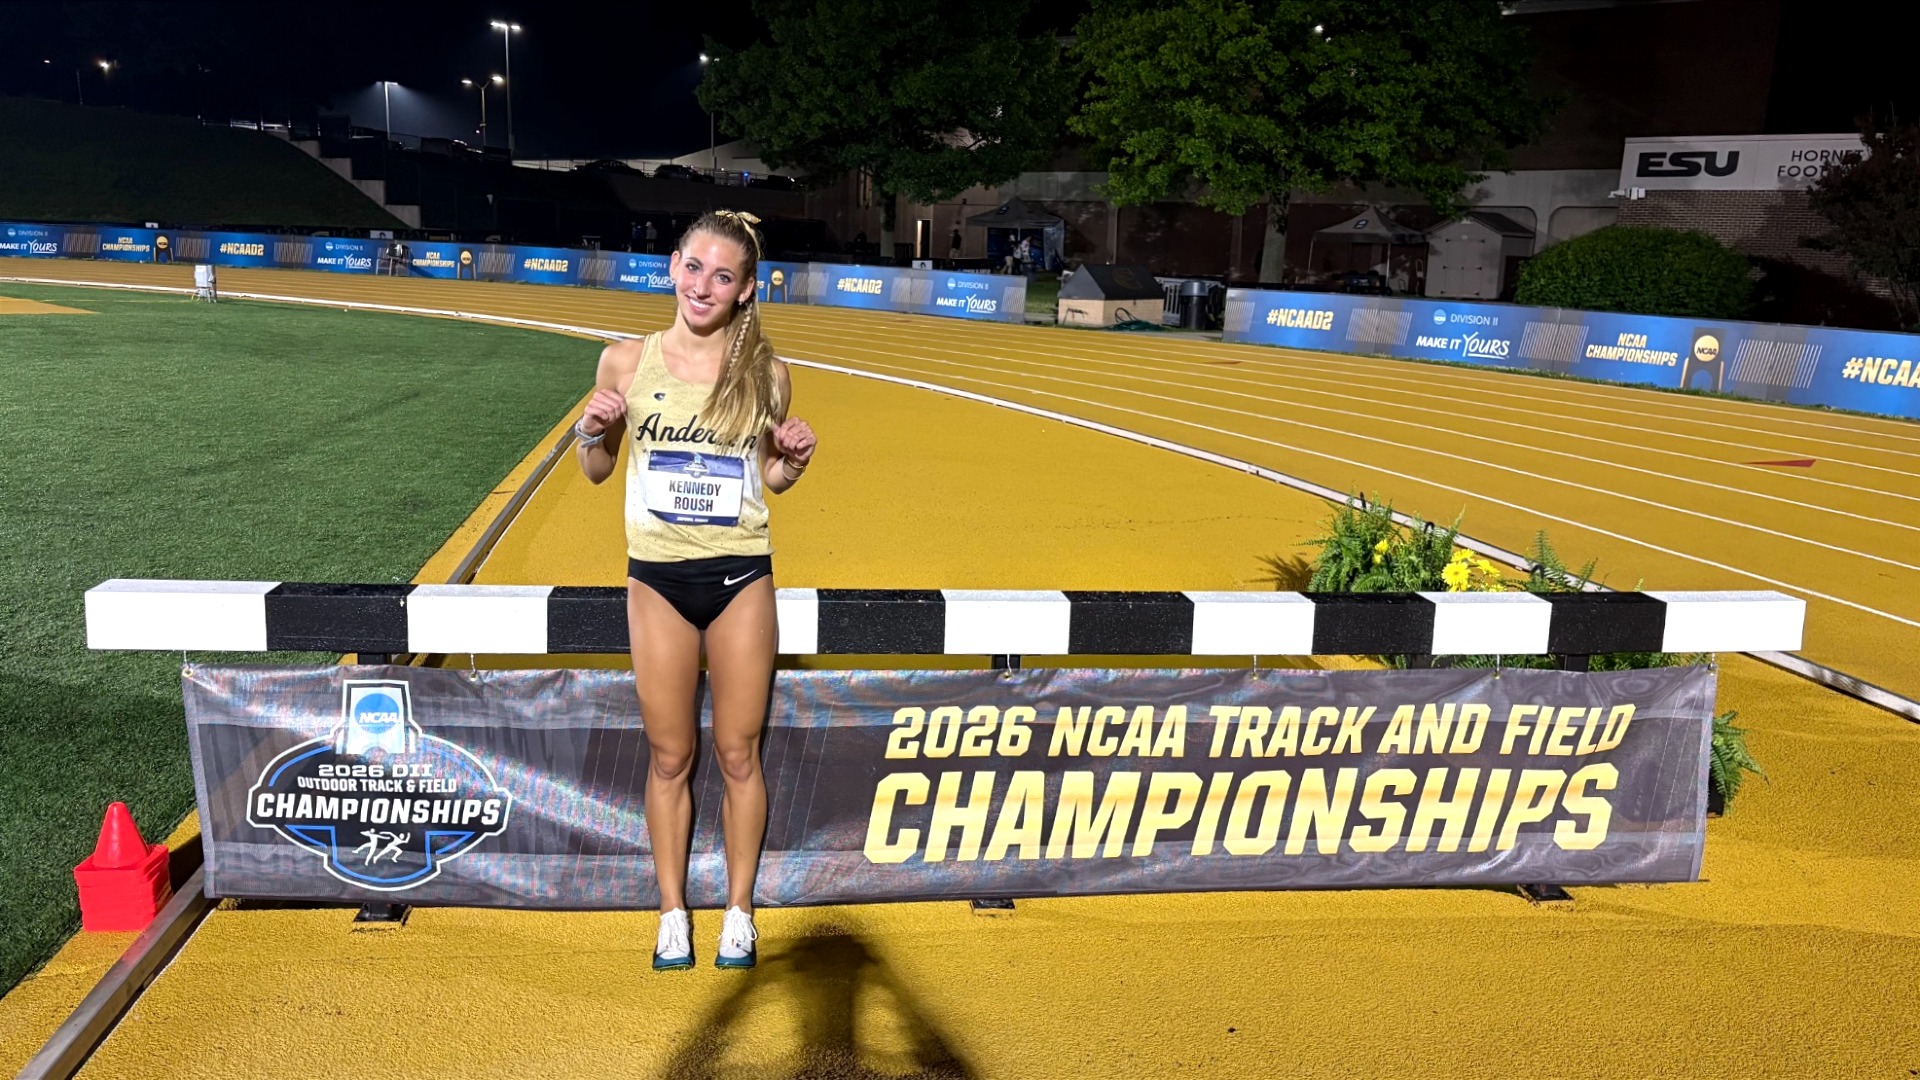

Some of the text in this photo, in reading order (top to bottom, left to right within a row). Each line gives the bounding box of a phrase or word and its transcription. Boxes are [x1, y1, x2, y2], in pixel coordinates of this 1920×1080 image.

[1636, 151, 1740, 178] ESU
[28, 239, 58, 254] YOURS
[102, 243, 150, 252] CHAMPIONSHIPS
[220, 242, 264, 256] #NCAAD2
[317, 257, 336, 265] MAKE
[344, 254, 372, 269] YOURS
[412, 258, 455, 268] CHAMPIONSHIPS
[425, 252, 440, 260] NCAA
[523, 258, 569, 272] #NCAAD2
[620, 271, 676, 289] MAKE IT YOURS
[837, 278, 883, 294] #NCAAD2
[958, 281, 984, 289] DIVISION
[936, 294, 997, 313] MAKE IT YOURS
[1266, 308, 1334, 330] #NCAAD2
[1450, 313, 1491, 326] DIVISION
[1416, 331, 1510, 359] MAKE IT YOURS
[1617, 333, 1647, 348] NCAA
[1585, 344, 1678, 367] CHAMPIONSHIPS
[635, 412, 758, 449] Andern
[669, 480, 721, 496] KENNEDY
[674, 496, 714, 512] ROUSH
[358, 711, 400, 724] NCAA
[884, 703, 1636, 759] 2026 NCAA TRACK AND FIELD
[318, 764, 432, 777] 2026 DII
[297, 776, 457, 793] OUTDOOR TRACK & FIELD
[256, 793, 501, 825] CHAMPIONSHIPS
[863, 763, 1619, 864] CHAMPIONSHIPS
